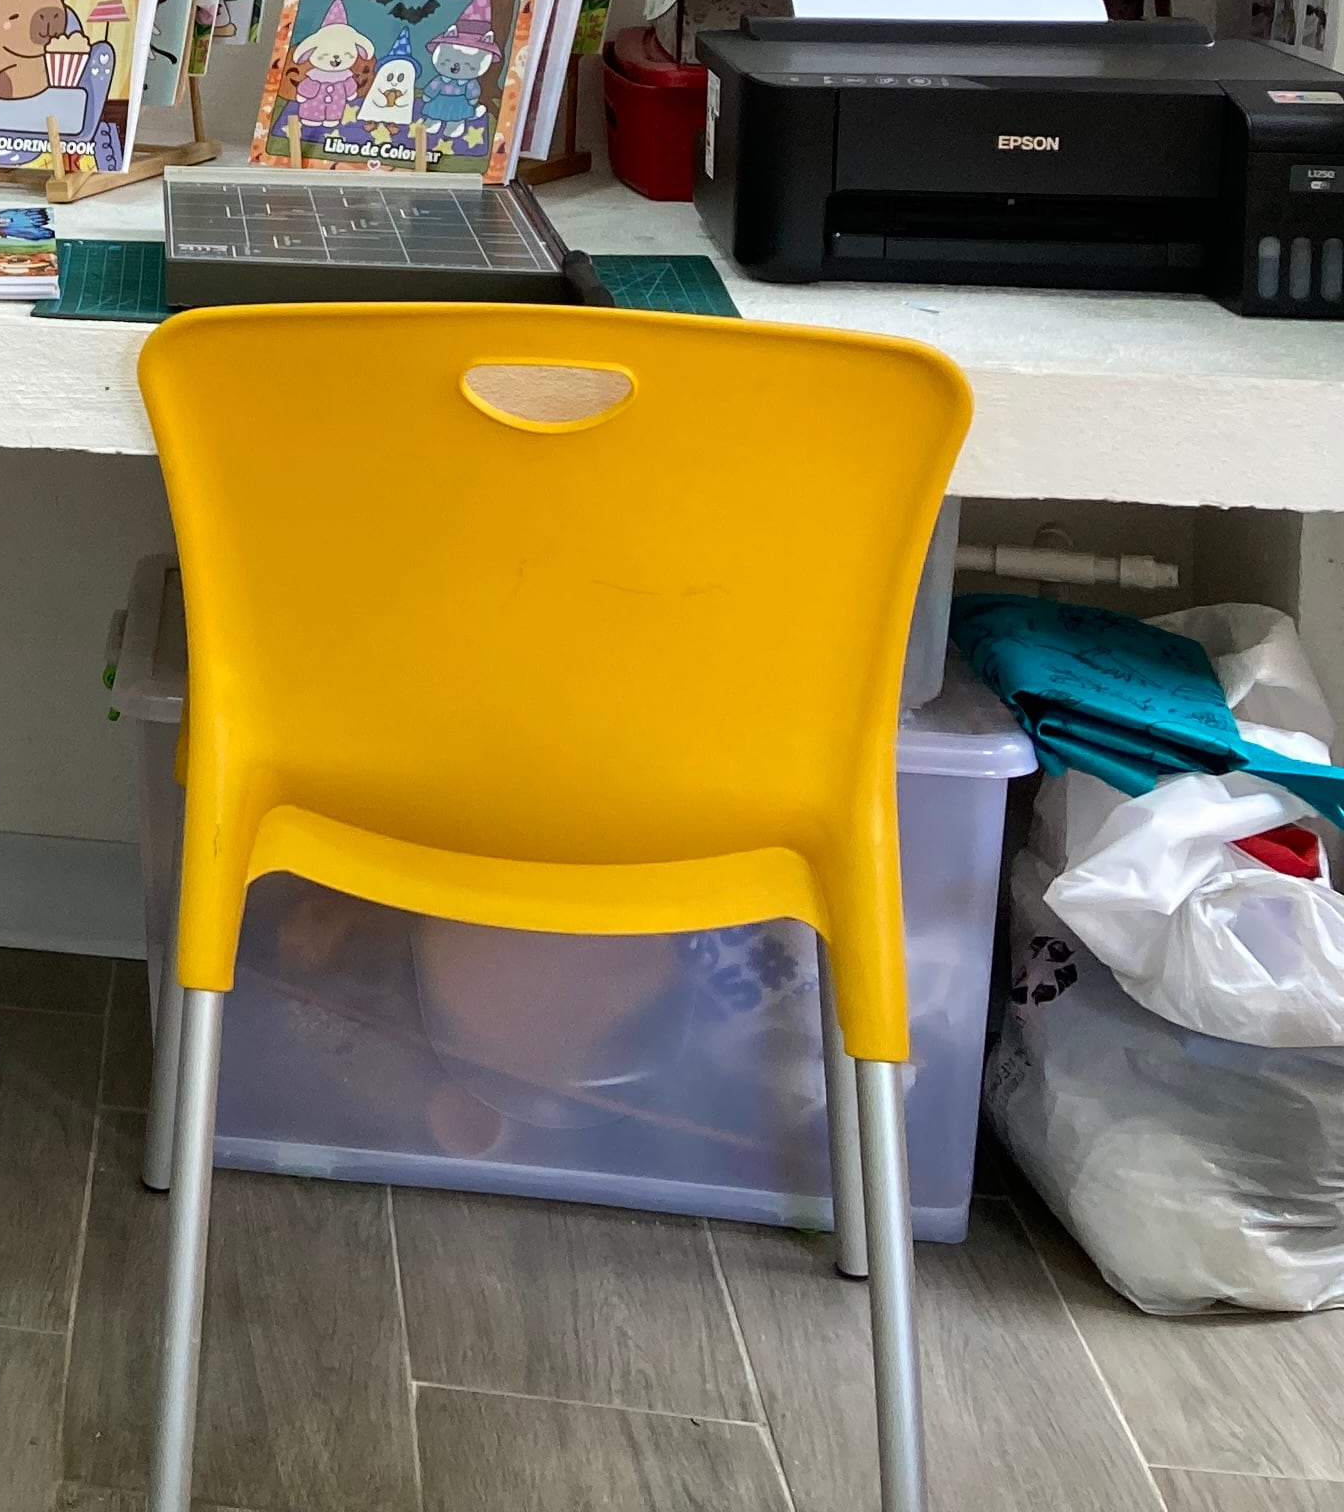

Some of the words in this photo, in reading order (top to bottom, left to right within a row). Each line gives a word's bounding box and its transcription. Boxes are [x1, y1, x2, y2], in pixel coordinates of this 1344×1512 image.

[325, 139, 359, 155] Libro
[361, 142, 379, 157] de
[381, 144, 441, 163] Colorar
[998, 136, 1060, 150] EPSON
